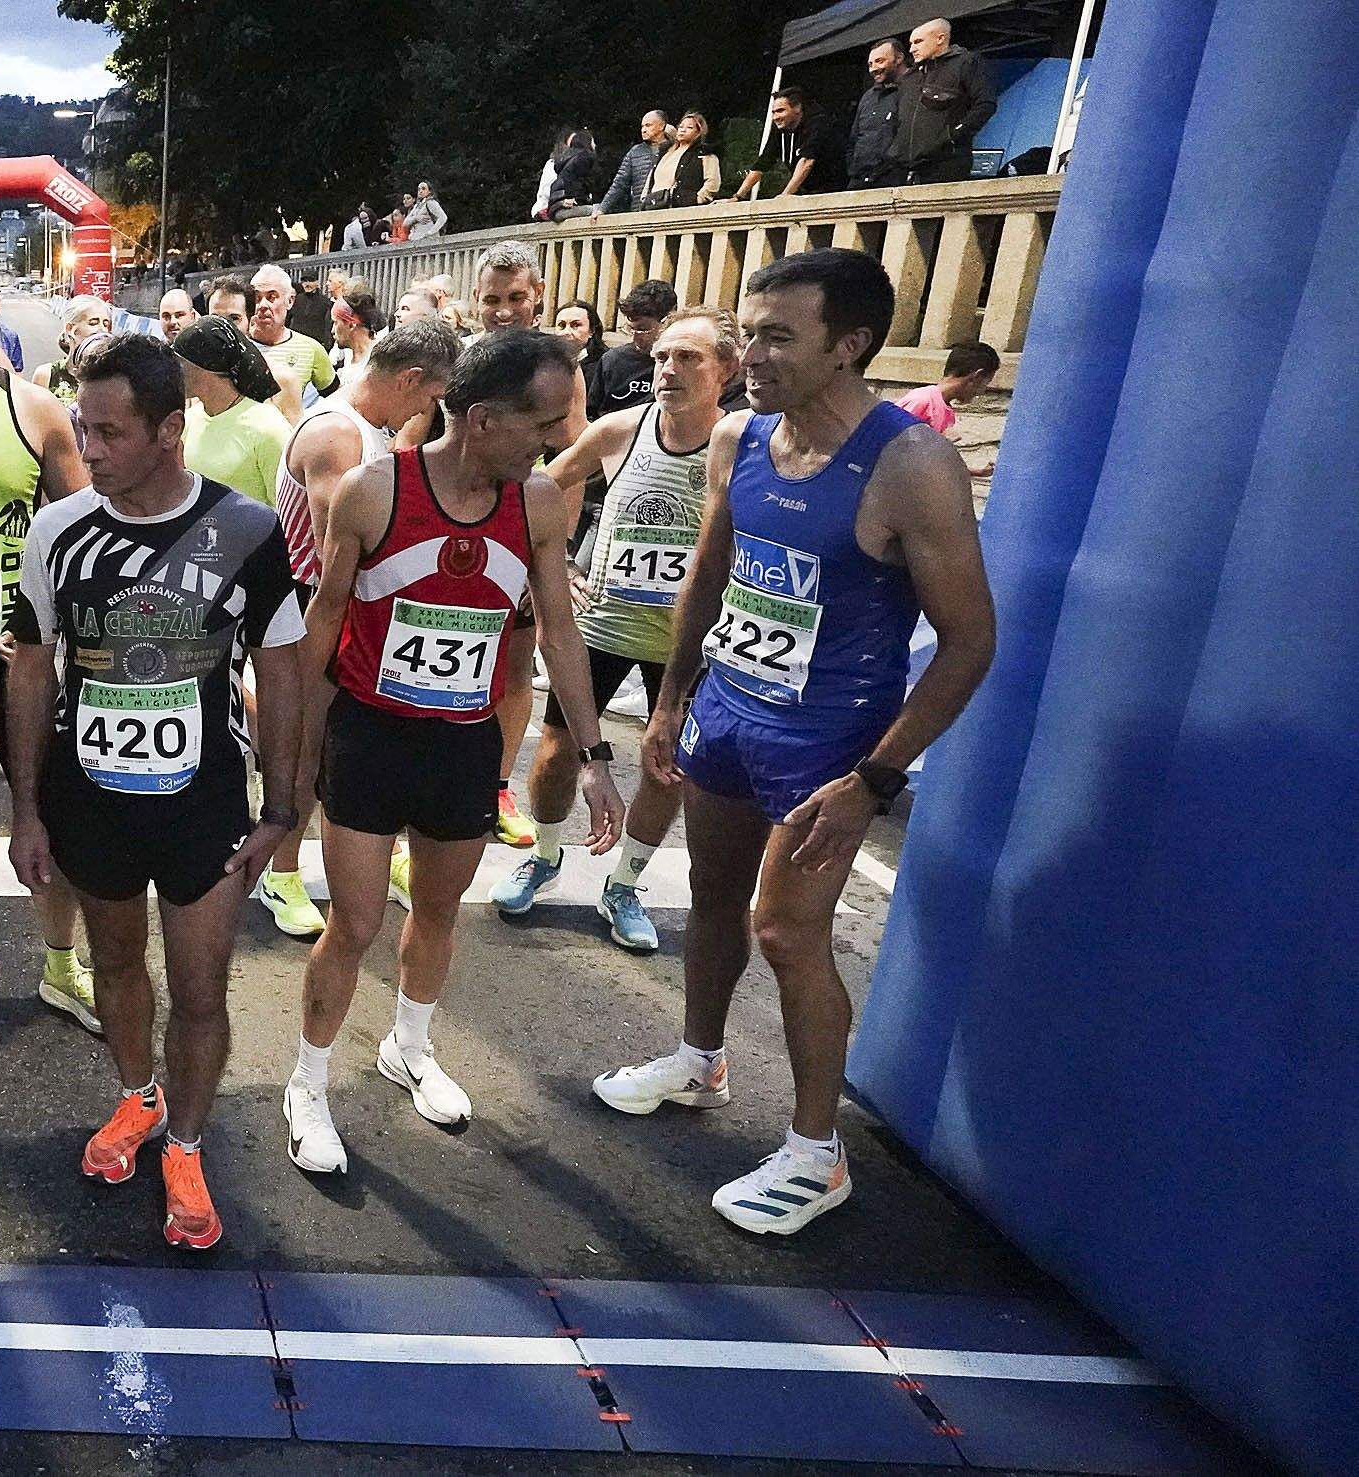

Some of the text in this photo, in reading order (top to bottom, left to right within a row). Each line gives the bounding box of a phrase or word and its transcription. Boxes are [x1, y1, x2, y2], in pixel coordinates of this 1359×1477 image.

[47, 176, 91, 211] FROIZ
[613, 548, 688, 582] 413
[733, 547, 786, 587] Ainé
[106, 584, 186, 607] RESTAURANTE
[72, 602, 100, 638] LA
[451, 620, 497, 630] MIGUEL
[392, 635, 488, 679] 431
[712, 612, 797, 673] 422
[134, 696, 187, 708] MIGUEL
[81, 716, 187, 760] 420
